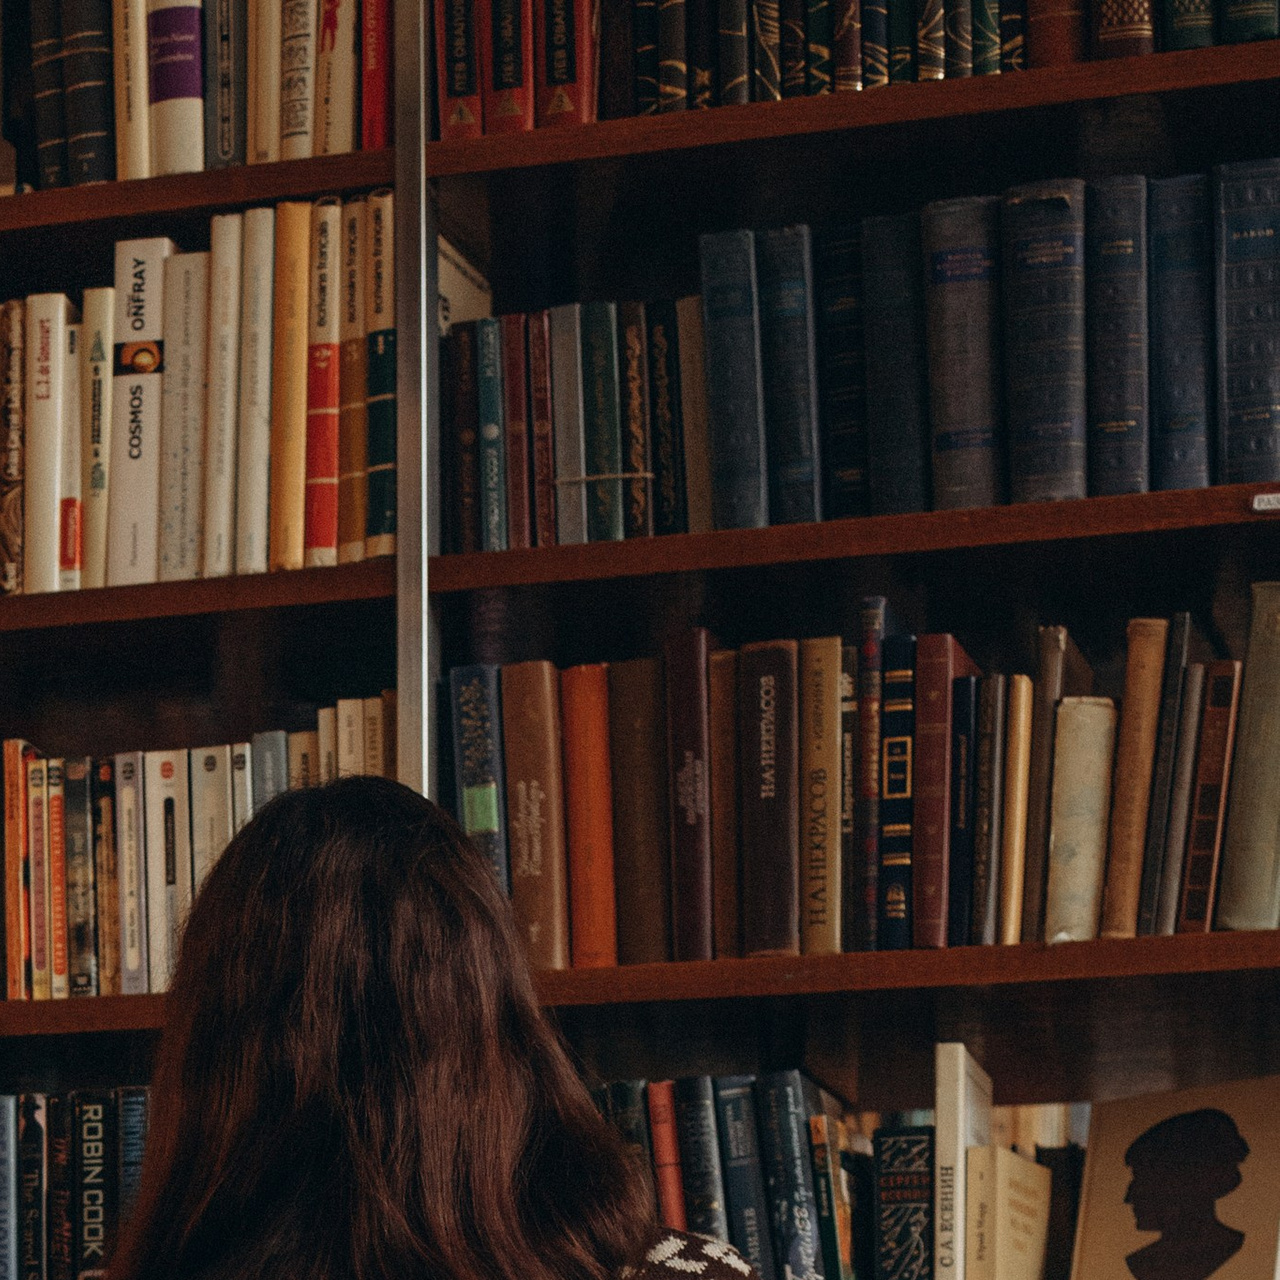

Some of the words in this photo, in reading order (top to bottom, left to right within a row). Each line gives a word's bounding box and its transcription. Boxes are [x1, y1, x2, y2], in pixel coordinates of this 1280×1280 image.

[316, 221, 331, 271] français
[345, 216, 359, 267] français
[371, 207, 385, 259] français
[131, 257, 148, 332] ONFRAY
[128, 384, 144, 461] COSMOS
[82, 1103, 104, 1184] ROBIN
[22, 1168, 39, 1203] The
[940, 1165, 954, 1233] ЕСЕНИН
[22, 1208, 40, 1268] Scared
[82, 1188, 104, 1258] COOK
